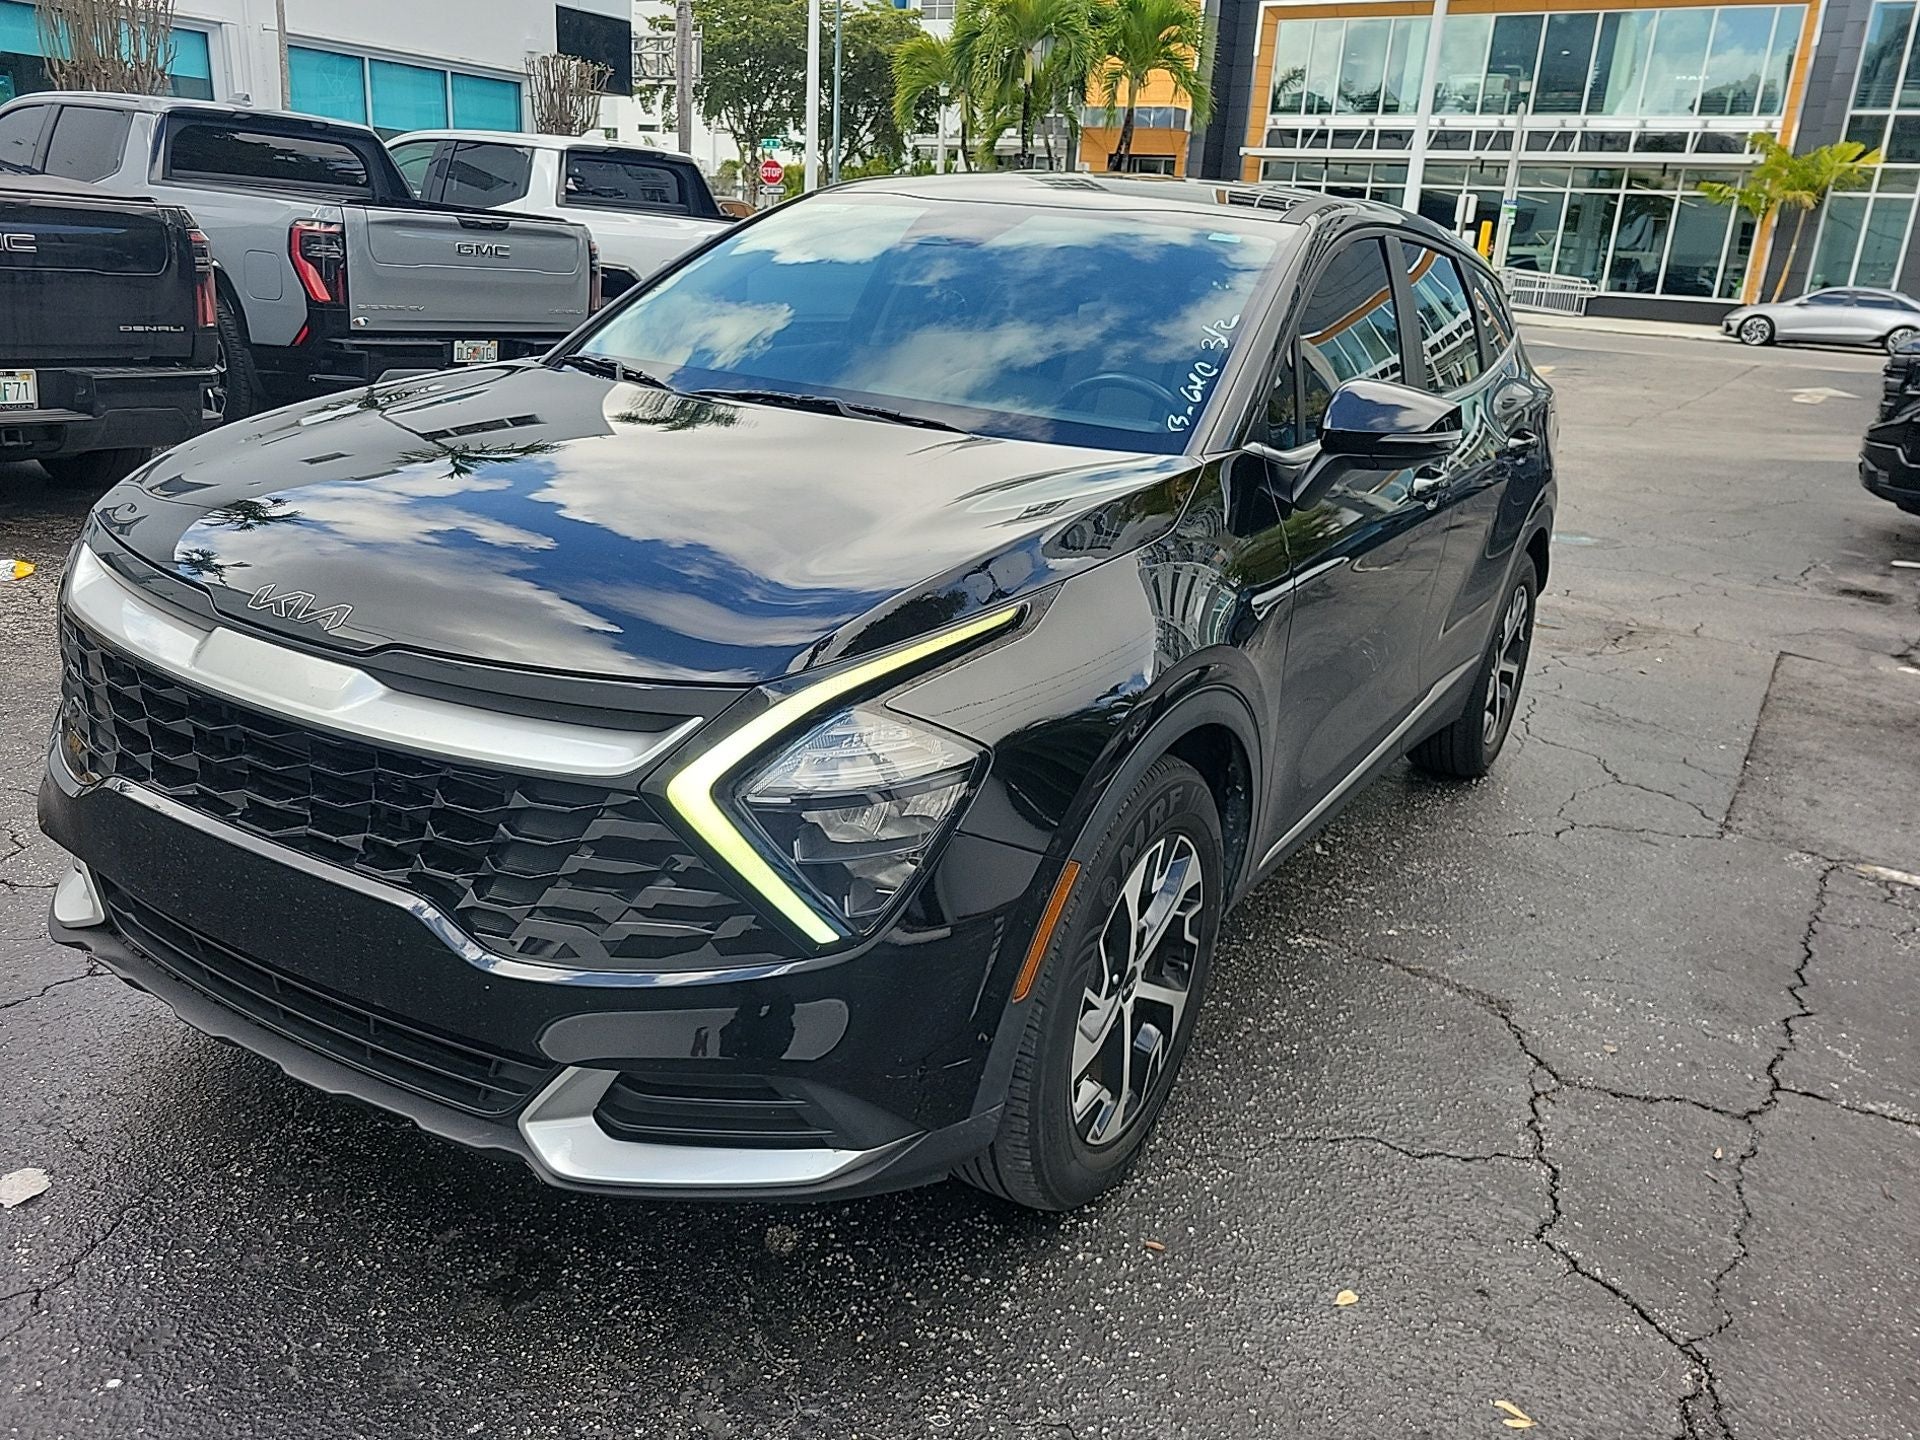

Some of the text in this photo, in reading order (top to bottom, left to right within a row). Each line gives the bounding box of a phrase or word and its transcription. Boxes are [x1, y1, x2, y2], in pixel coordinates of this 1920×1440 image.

[762, 167, 782, 178] STOP
[0, 232, 37, 253] C
[455, 241, 511, 258] GMC
[246, 583, 354, 631] KIA
[1119, 784, 1184, 878] MRF
